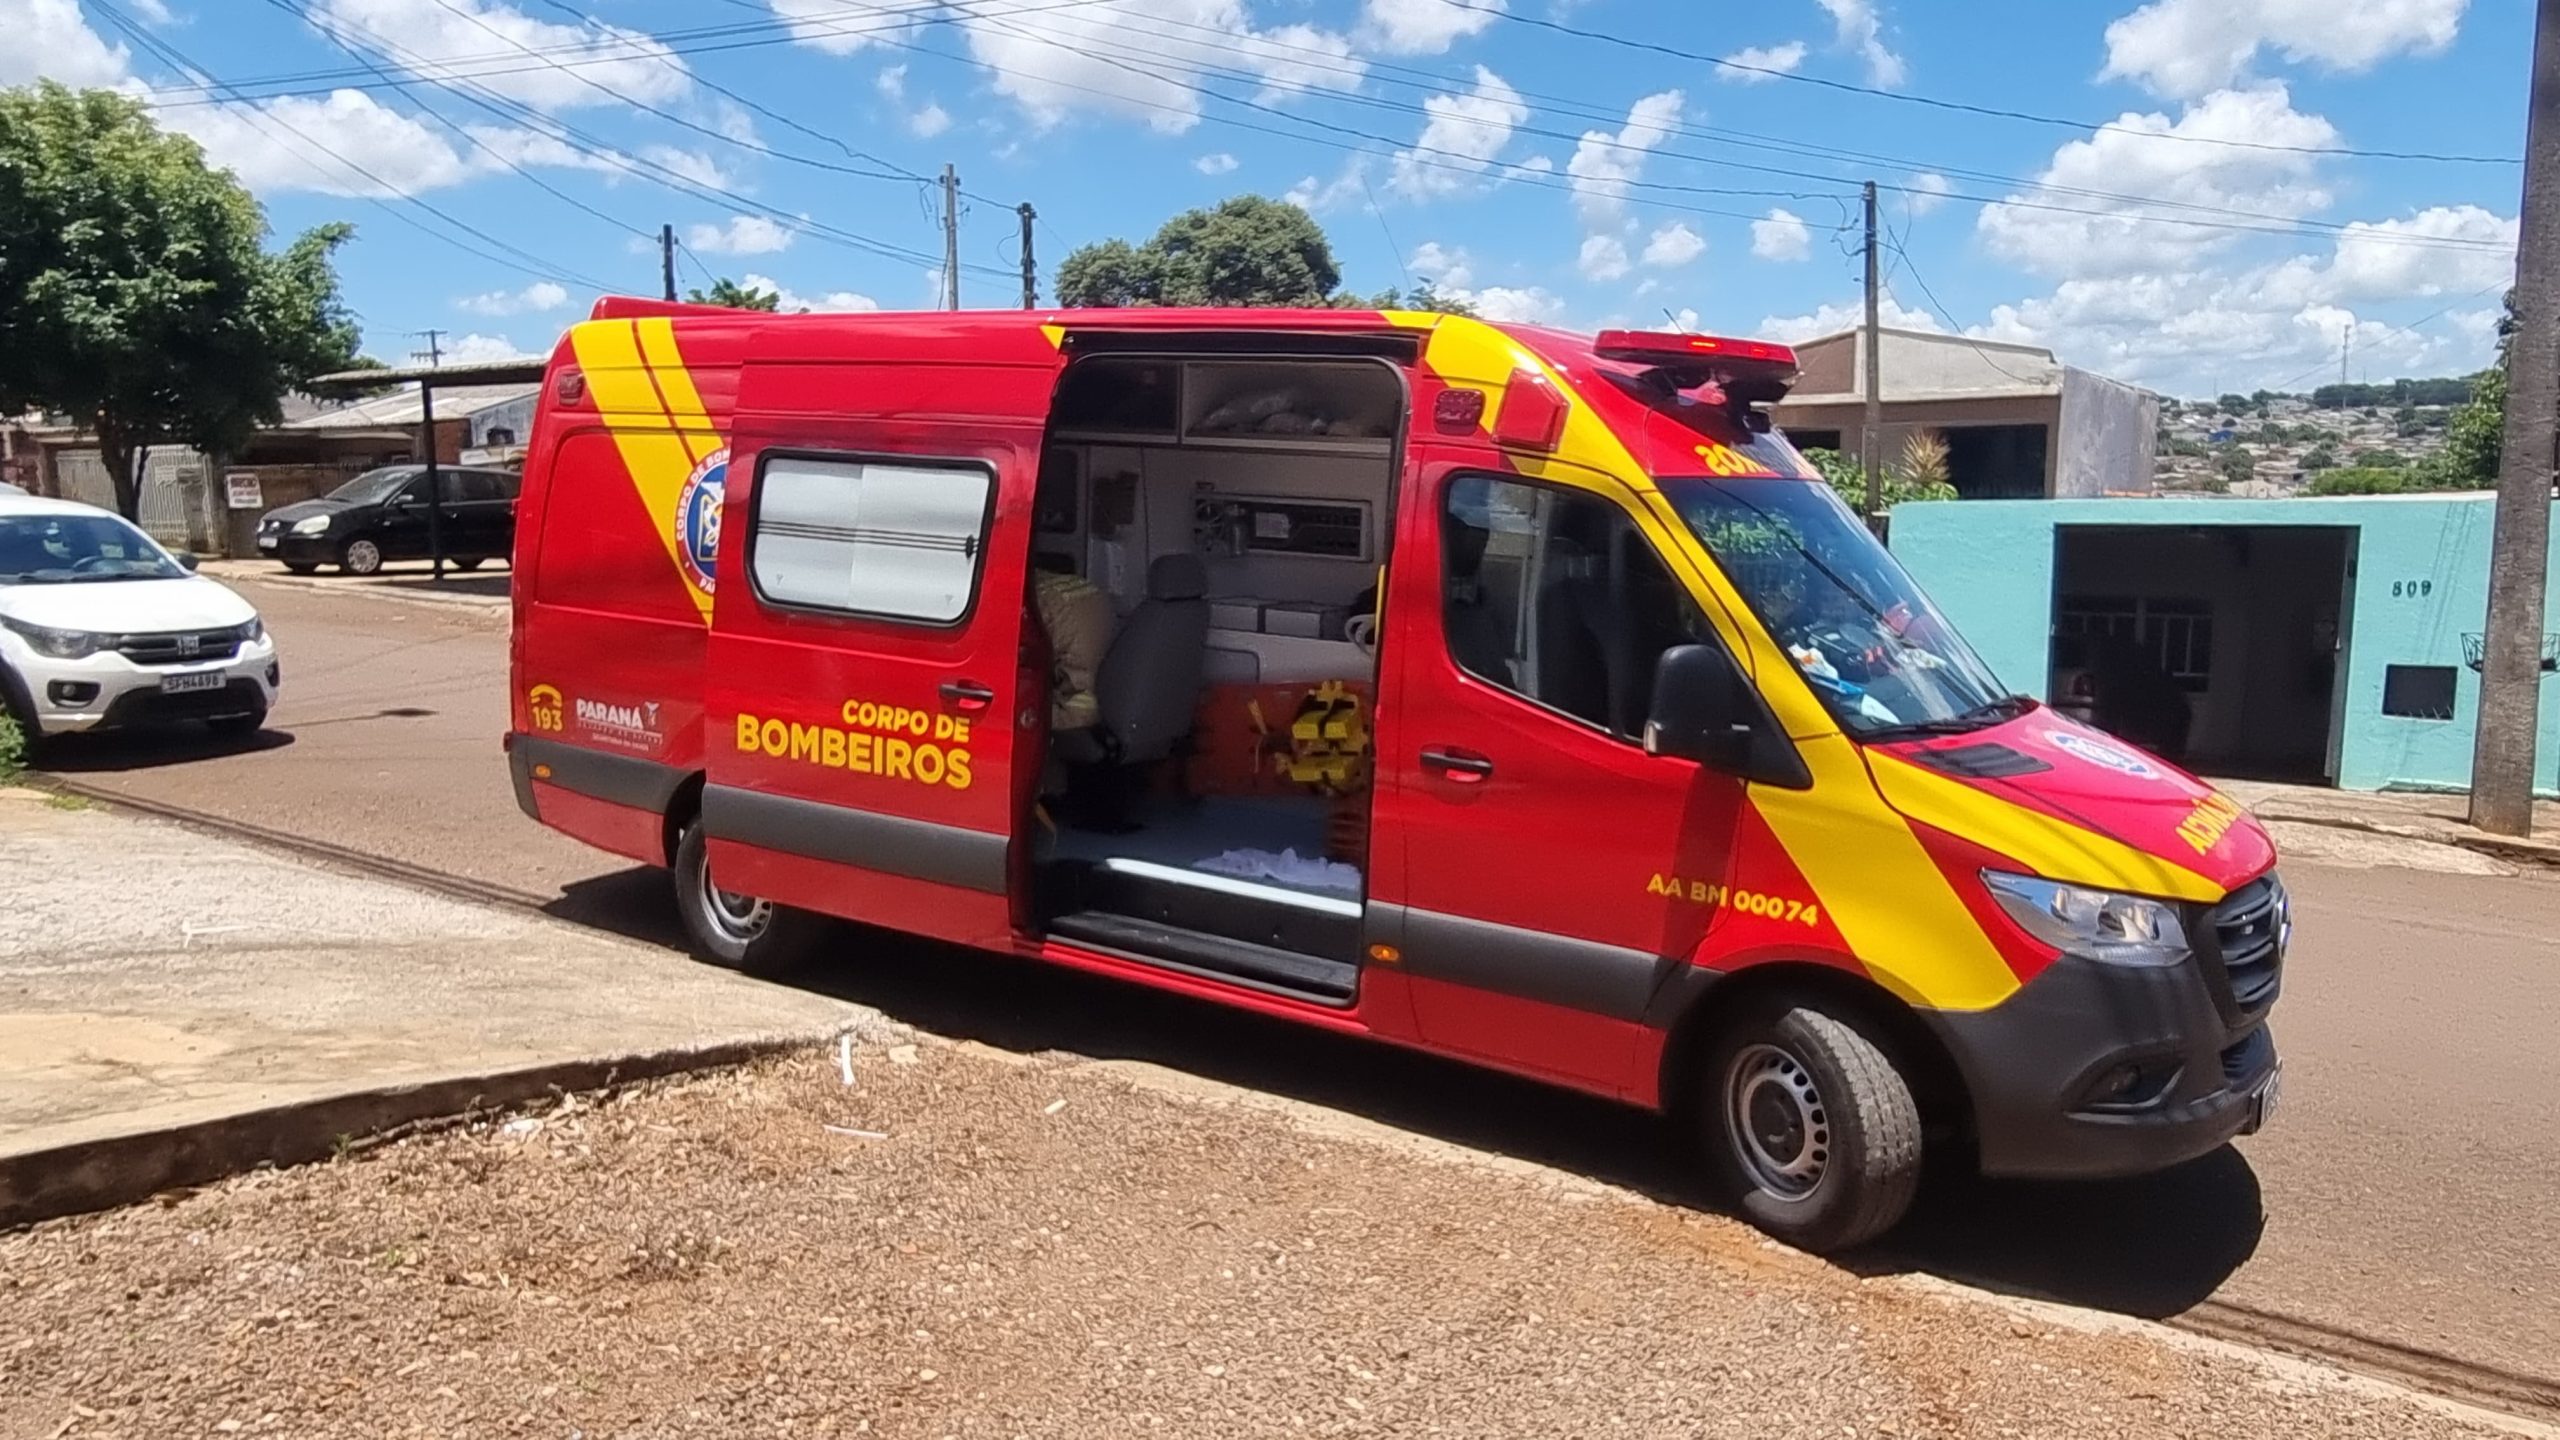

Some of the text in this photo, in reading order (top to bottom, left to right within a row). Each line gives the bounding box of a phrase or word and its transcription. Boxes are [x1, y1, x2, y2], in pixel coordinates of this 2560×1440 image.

[676, 484, 692, 541] CORPO
[690, 465, 705, 485] DE
[2392, 580, 2432, 599] 809
[532, 705, 563, 732] 193
[842, 699, 971, 743] CORPO DE
[737, 712, 972, 789] BOMBEIROS
[1646, 873, 1818, 928] AA BM 00074
